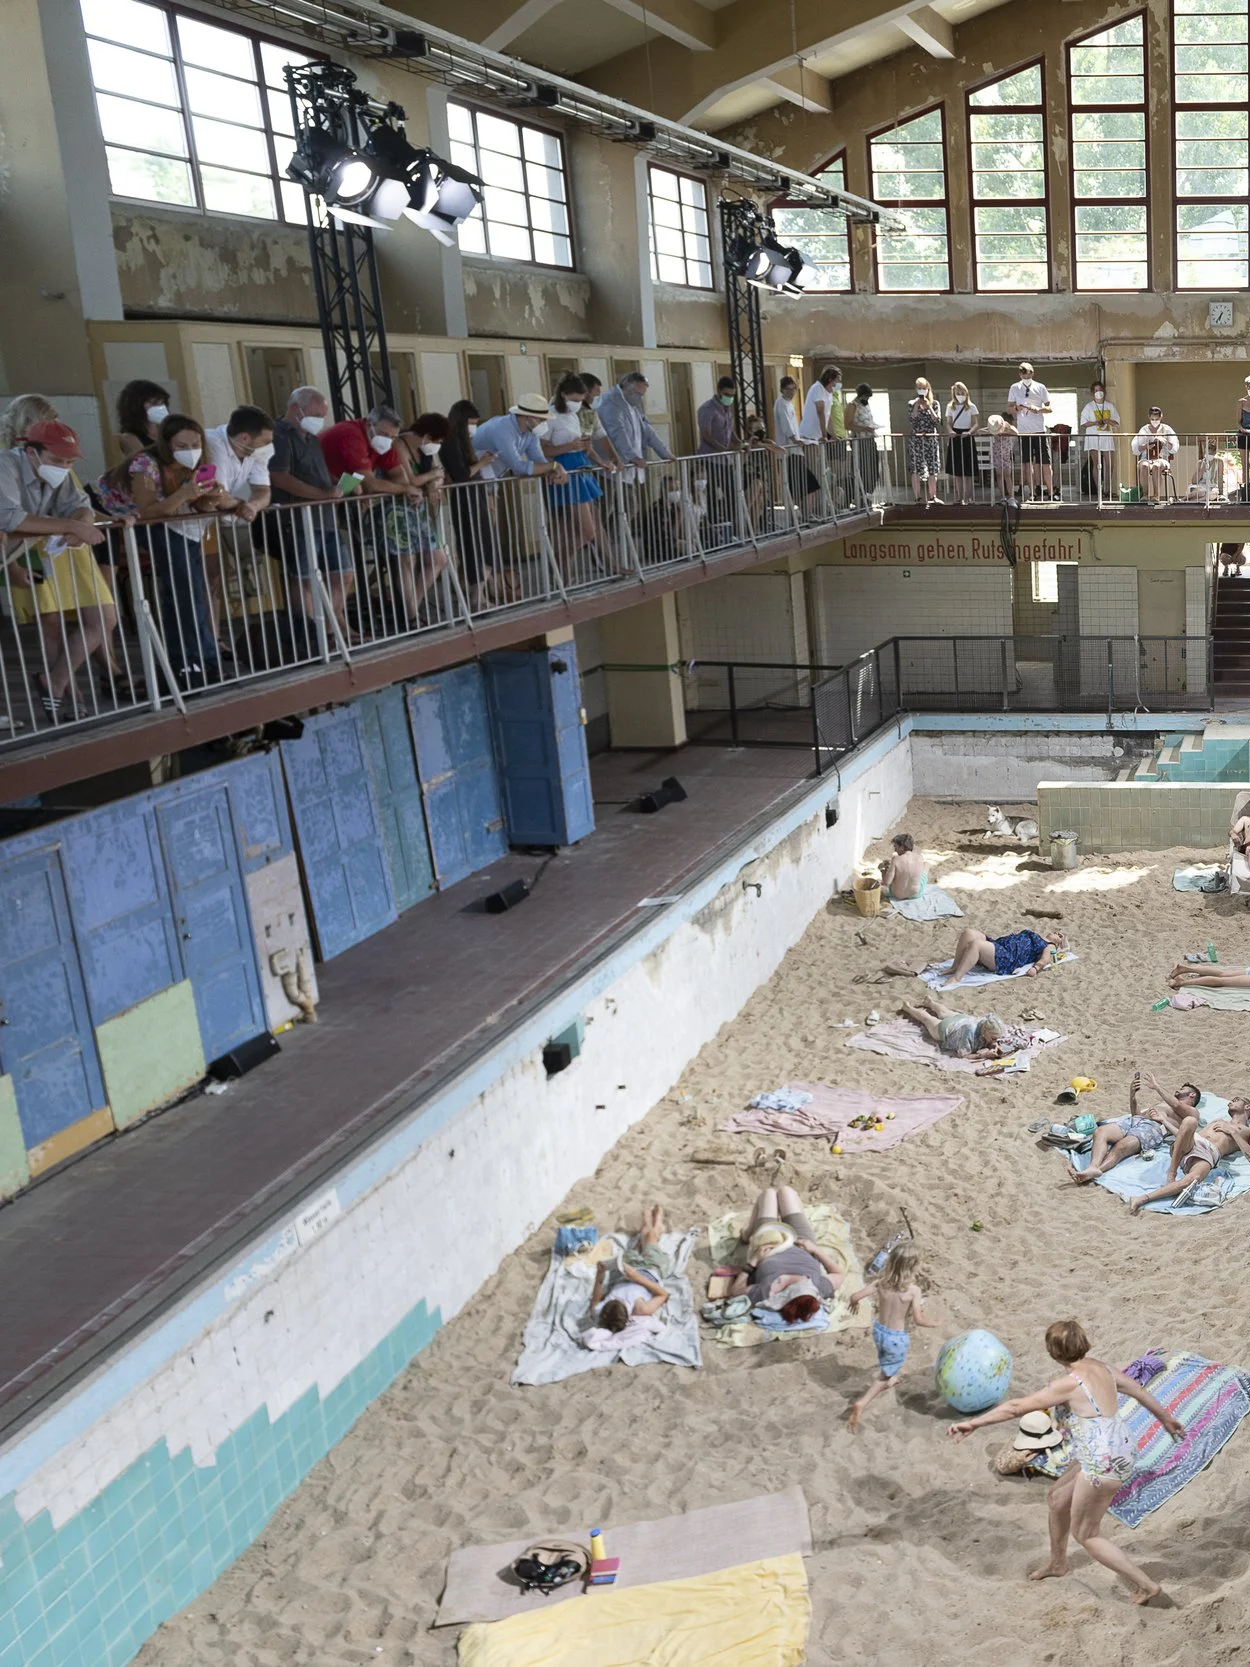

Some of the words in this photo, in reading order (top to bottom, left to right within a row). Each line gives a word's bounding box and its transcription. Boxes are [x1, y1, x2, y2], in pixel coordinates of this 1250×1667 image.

[843, 538, 911, 562] Langsam
[917, 538, 969, 562] gehen,
[972, 537, 1082, 562] Rutshgefahr!
